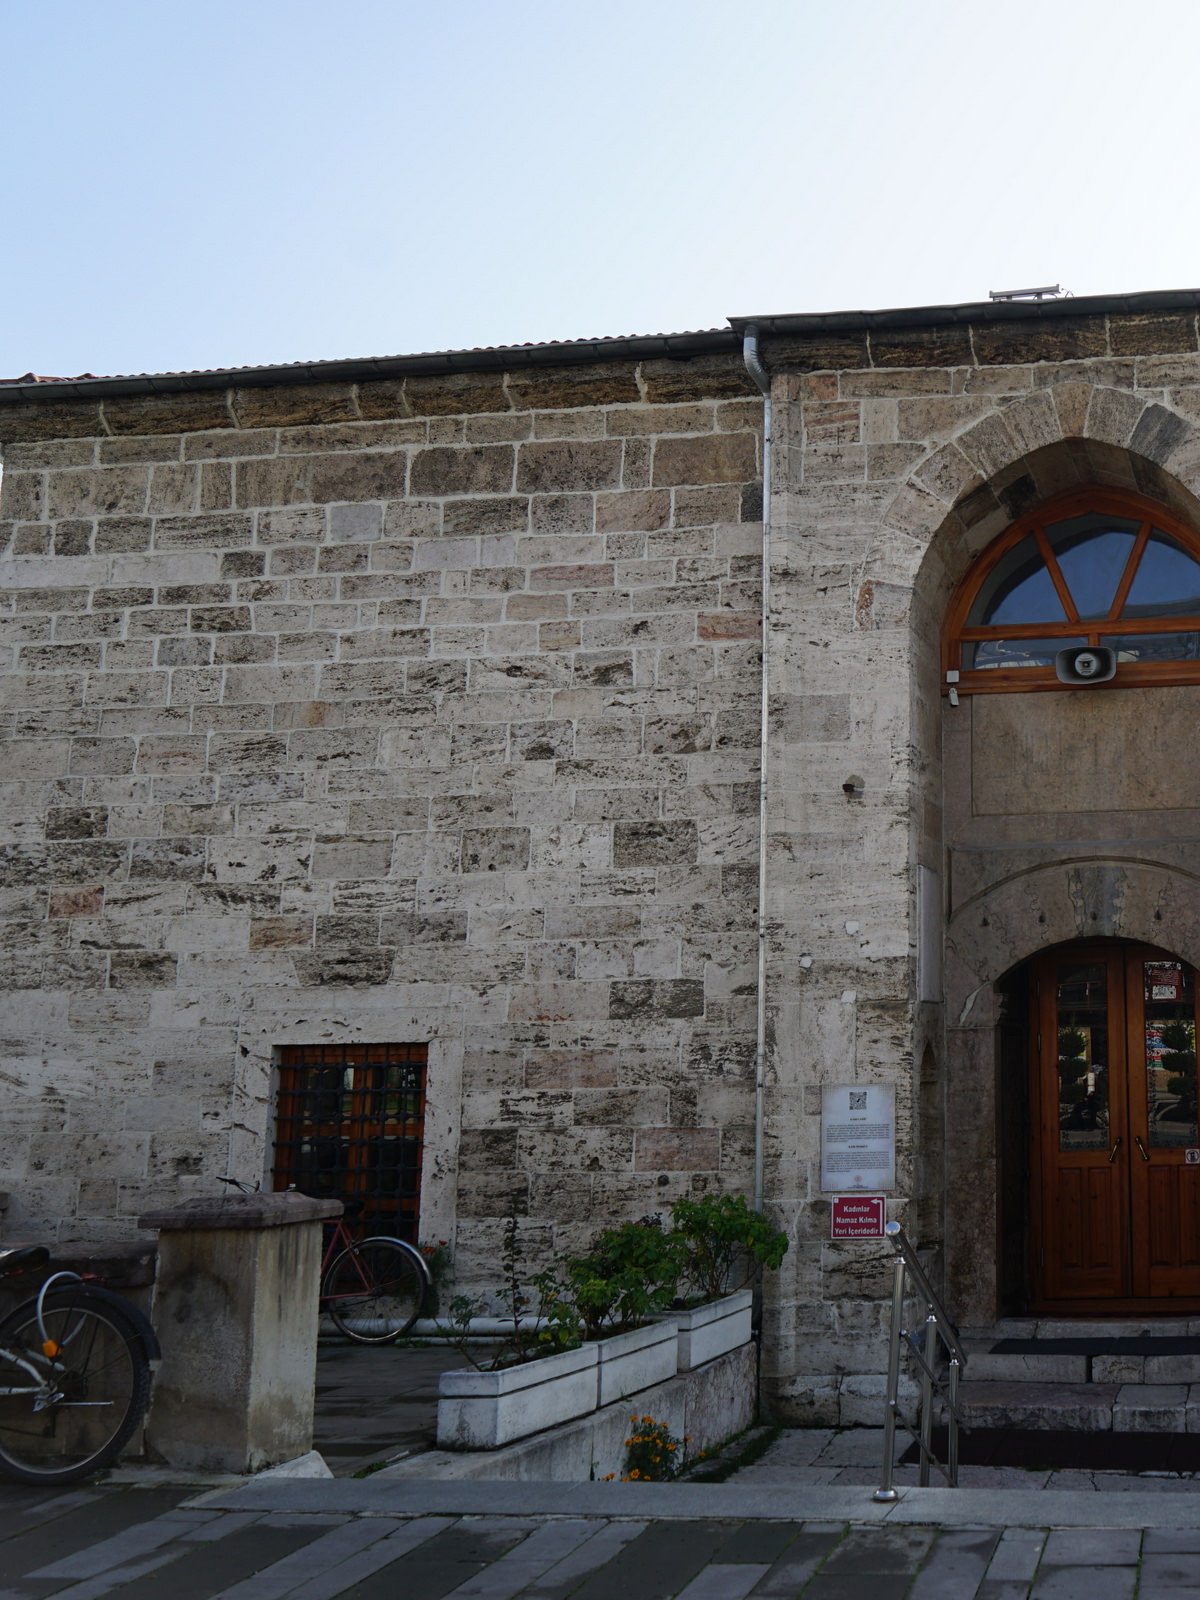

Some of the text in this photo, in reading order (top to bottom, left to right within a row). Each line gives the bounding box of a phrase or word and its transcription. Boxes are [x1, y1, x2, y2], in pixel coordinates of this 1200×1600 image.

[843, 1205, 870, 1213] Kadınlar
[836, 1216, 877, 1224] Namaz Kılma
[834, 1226, 879, 1236] Yeri İçeridedir
